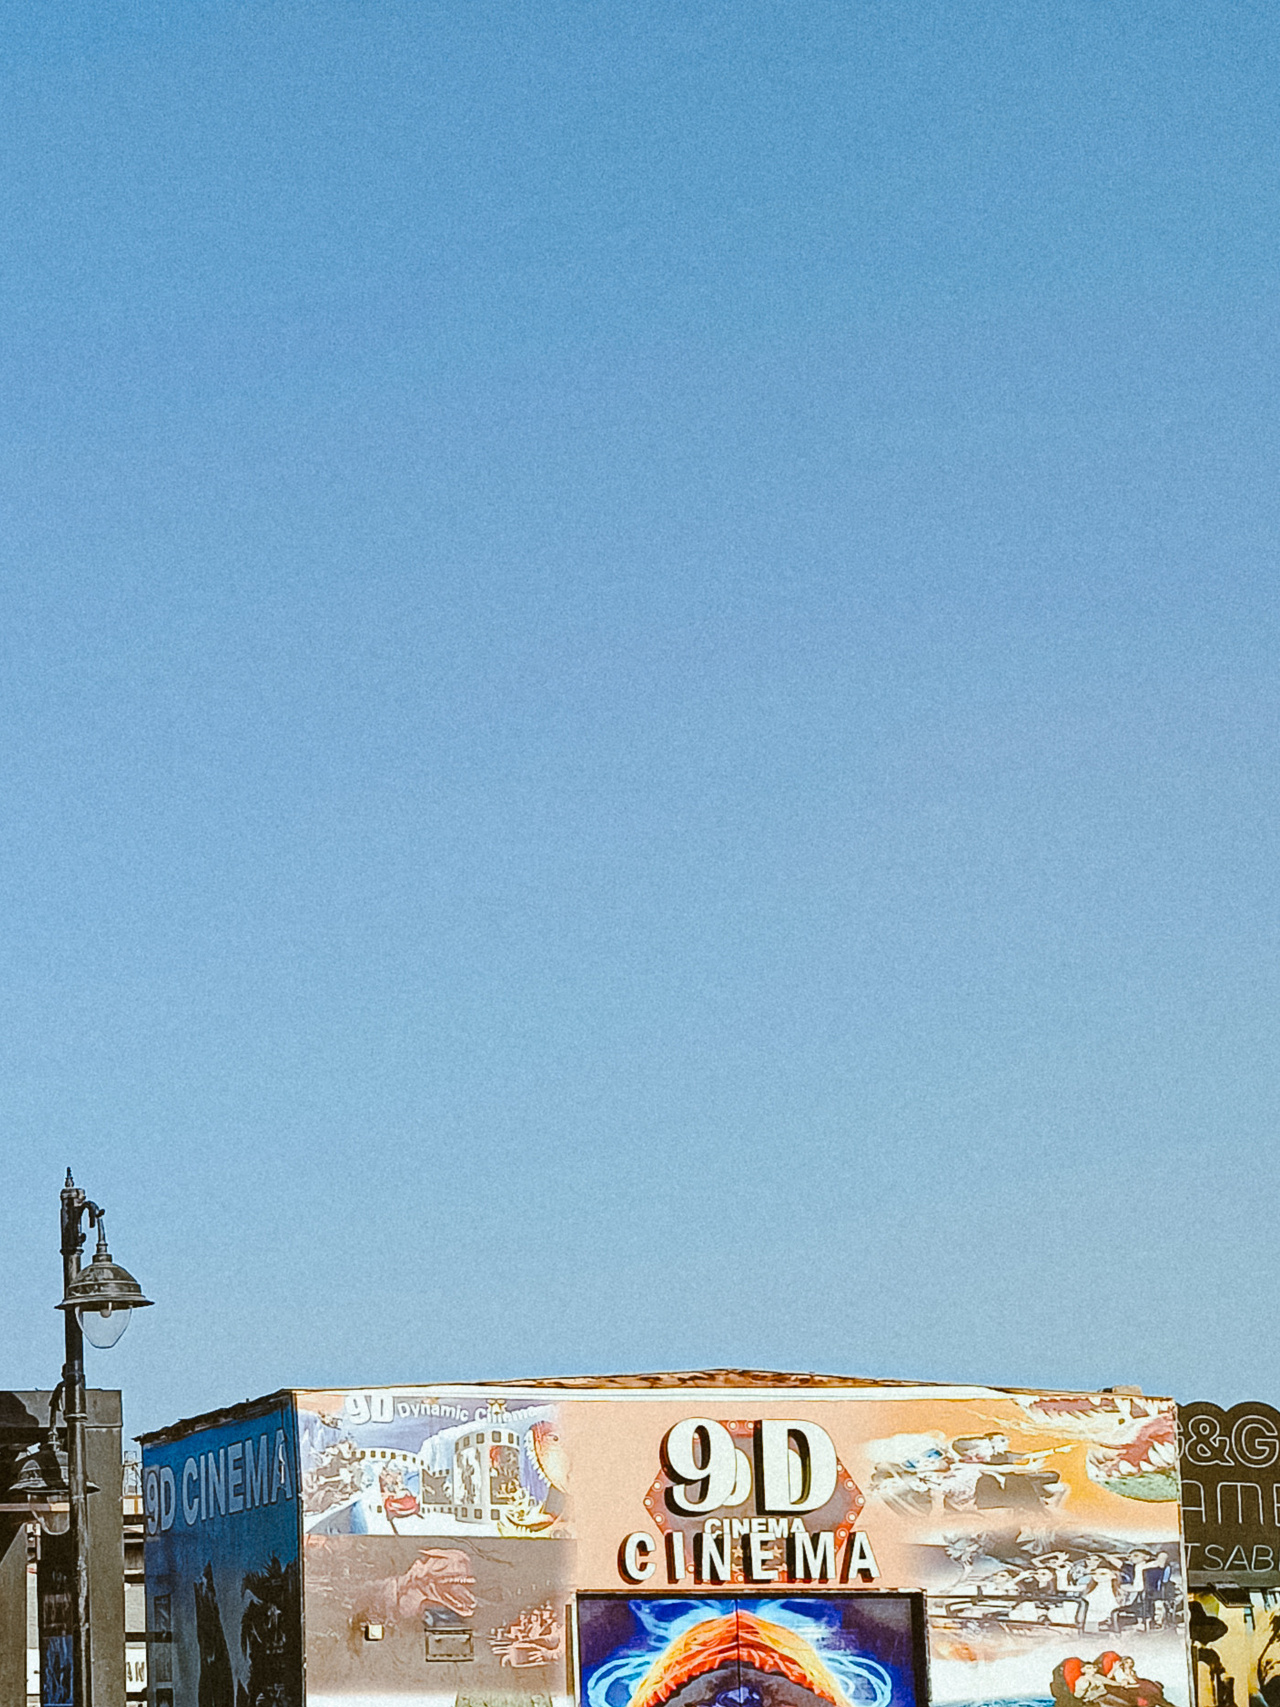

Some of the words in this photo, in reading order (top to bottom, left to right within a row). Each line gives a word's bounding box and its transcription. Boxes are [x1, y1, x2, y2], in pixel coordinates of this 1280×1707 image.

[397, 1402, 469, 1422] Dynamic
[146, 1466, 176, 1536] 9D
[182, 1428, 293, 1526] CINEMA
[661, 1417, 838, 1516] 9D
[618, 1531, 881, 1584] CINEMA
